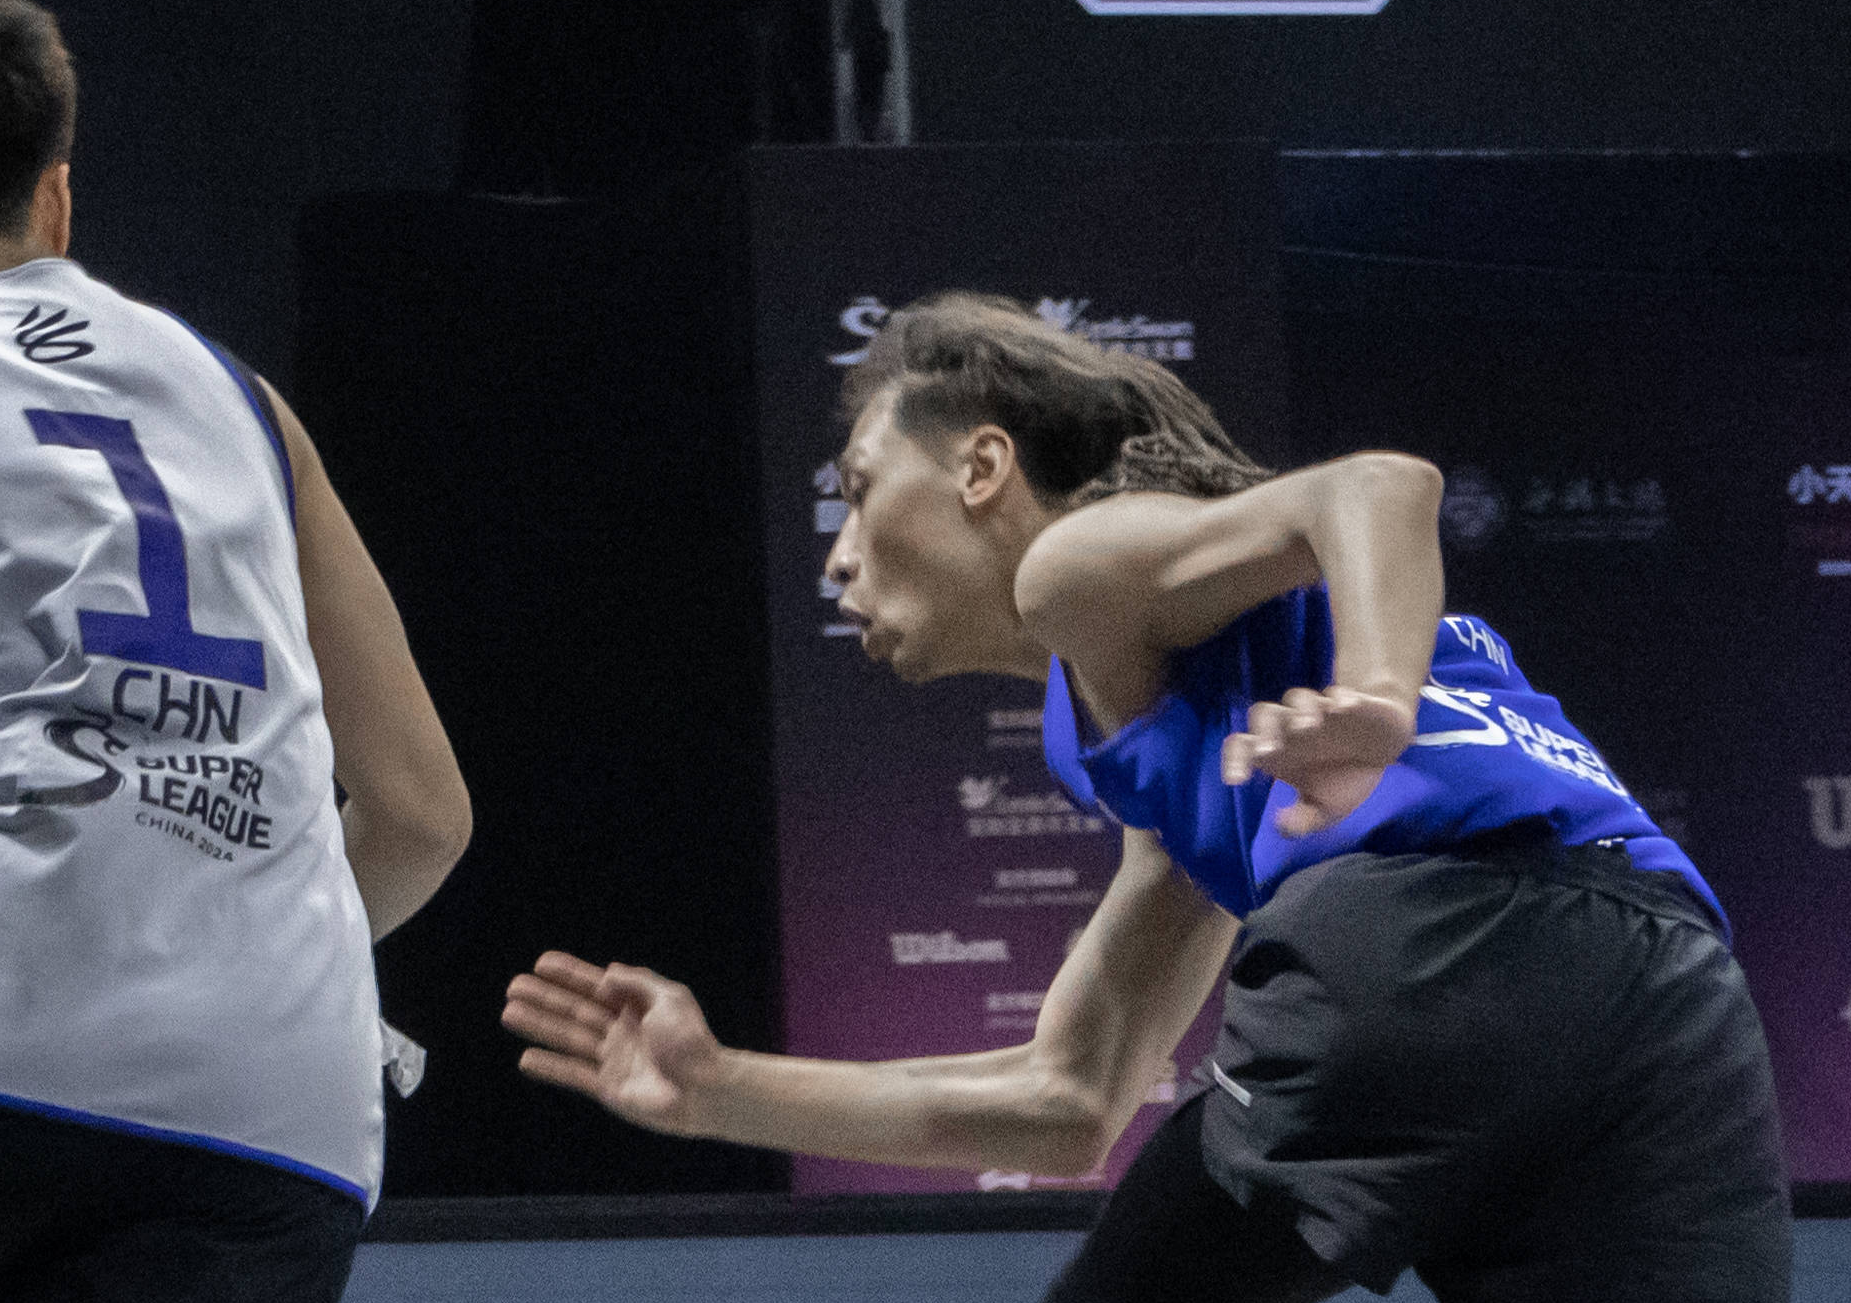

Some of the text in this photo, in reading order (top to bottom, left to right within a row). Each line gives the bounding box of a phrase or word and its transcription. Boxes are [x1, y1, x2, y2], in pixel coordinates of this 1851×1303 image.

[23, 408, 267, 690] 1
[112, 667, 243, 744] CHN
[135, 754, 265, 805] SUPER
[139, 773, 273, 850] LEAGUE
[134, 810, 195, 844] CHINA
